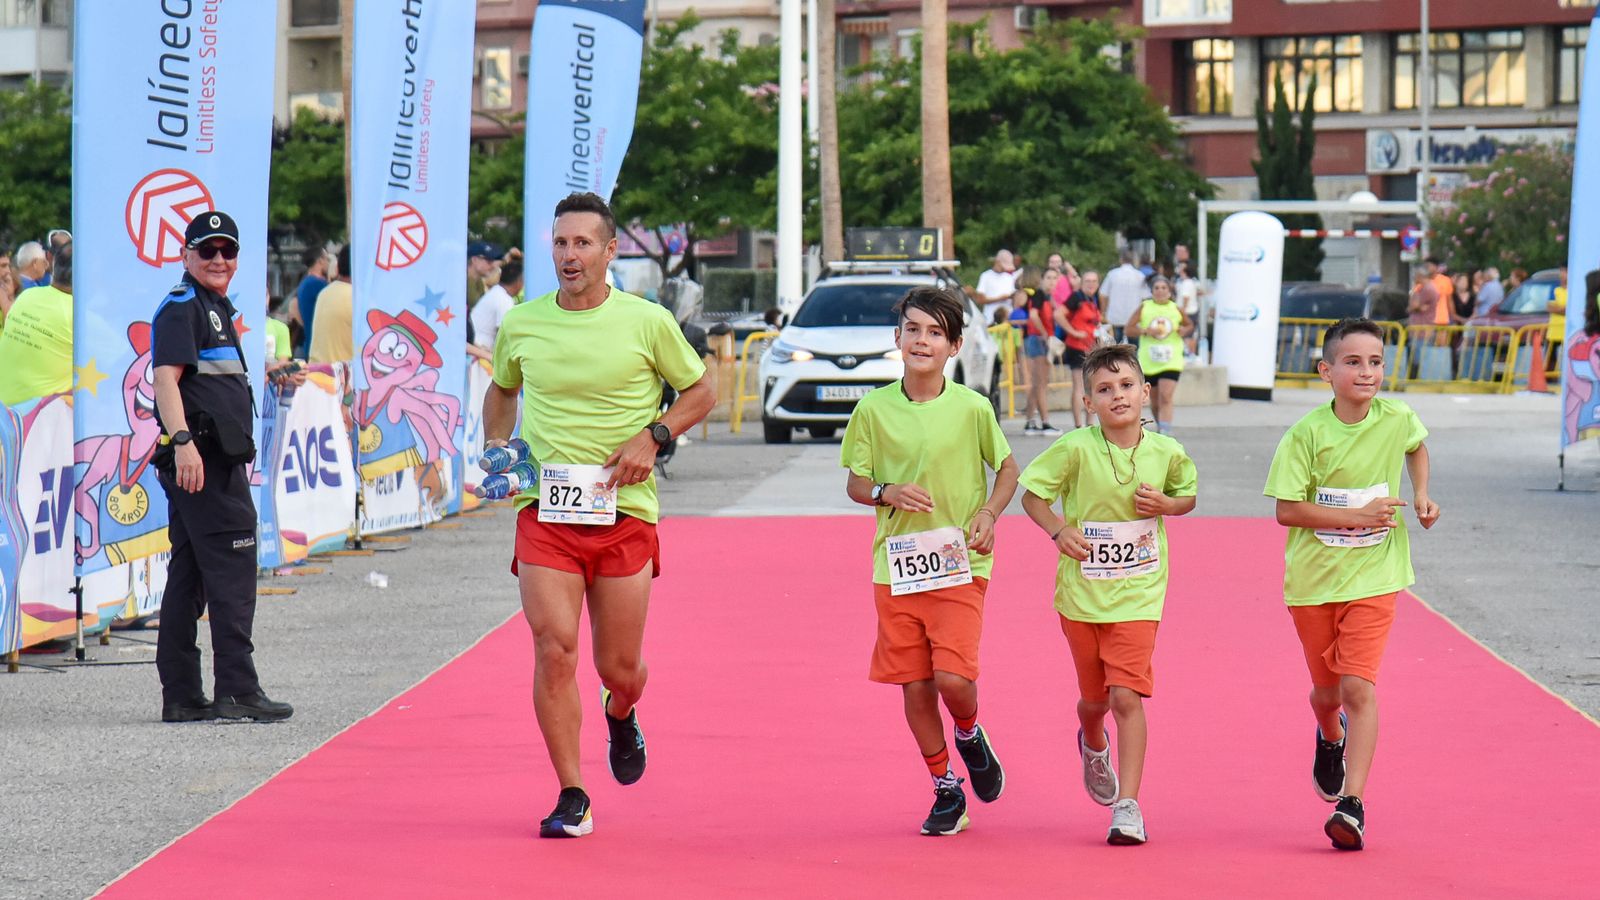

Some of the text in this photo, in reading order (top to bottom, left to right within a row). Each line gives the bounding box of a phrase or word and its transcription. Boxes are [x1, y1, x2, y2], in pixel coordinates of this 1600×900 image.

[196, 66, 216, 153] Limitless
[566, 23, 596, 196] líneavertical
[415, 79, 435, 193] Limitless Safety
[543, 468, 556, 478] XXI
[109, 490, 144, 522] BOLARDITO
[549, 485, 582, 507] 872
[1318, 493, 1333, 502] XXI
[1084, 527, 1098, 537] XXI
[889, 541, 902, 551] XXI
[1090, 542, 1134, 564] 1532
[894, 551, 941, 578] 1530
